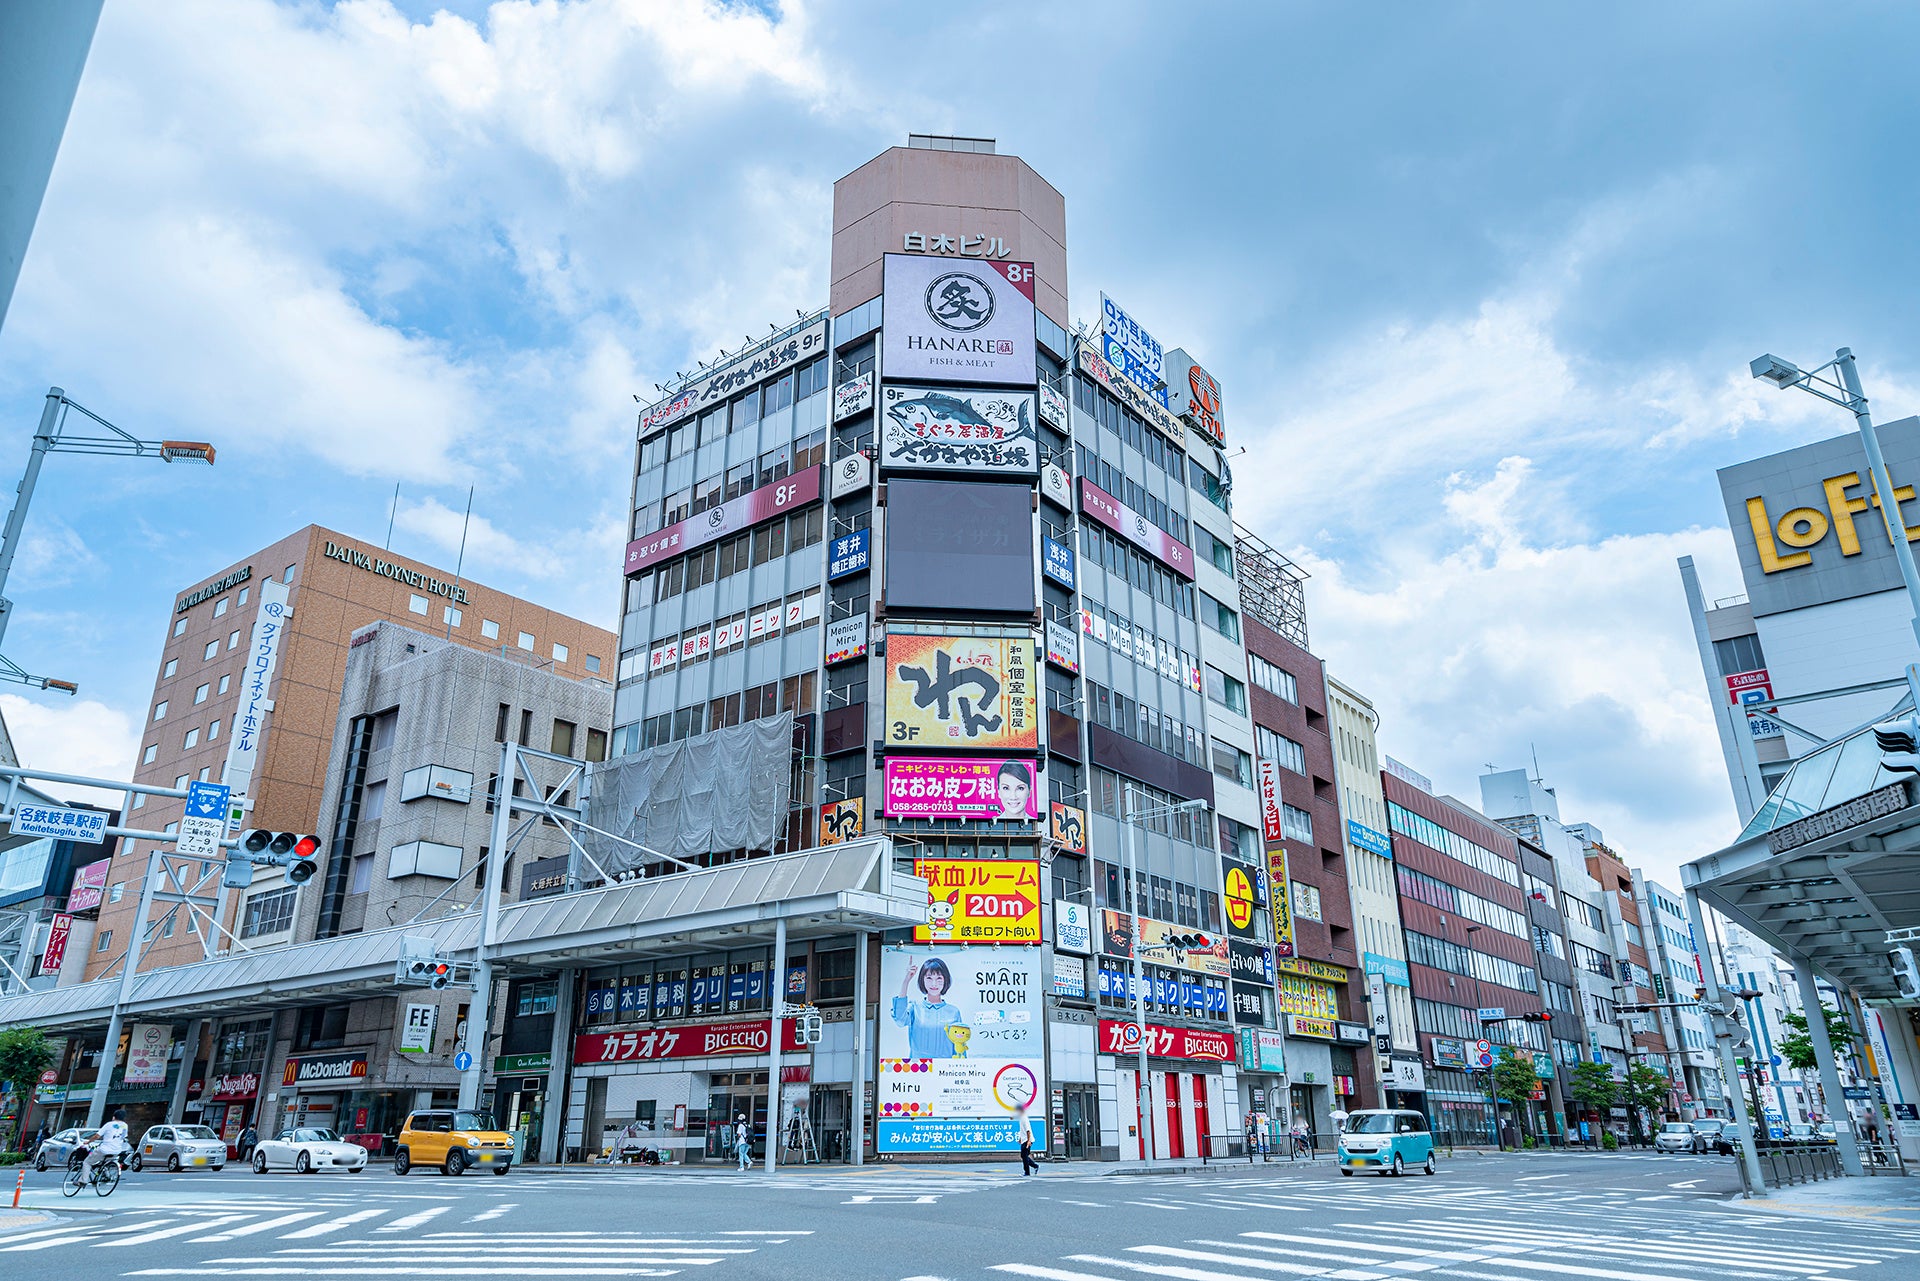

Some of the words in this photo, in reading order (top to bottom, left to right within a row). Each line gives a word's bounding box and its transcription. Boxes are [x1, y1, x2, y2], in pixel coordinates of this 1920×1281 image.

[903, 231, 1011, 258] 白木ビル
[1007, 263, 1033, 283] 8F
[802, 330, 823, 351] 9F
[908, 335, 995, 355] HANARE
[1108, 320, 1160, 373] クリニック
[929, 357, 953, 367] FISH
[955, 358, 964, 367] &
[965, 359, 996, 368] MEAT
[886, 388, 905, 401] 9F
[1172, 422, 1184, 440] 9F
[774, 483, 797, 507] 8F
[837, 536, 861, 558] 浅井
[1050, 542, 1068, 565] 浅井
[1171, 545, 1182, 562] 8F
[325, 541, 372, 570] DAIWA
[374, 559, 426, 590] ROYNET
[427, 577, 471, 605] HOTEL
[830, 550, 866, 577] 矯正歯科
[225, 565, 252, 589] HOTEL
[652, 605, 801, 666] 青木眼科クリニック
[830, 621, 863, 638] Menicon
[836, 633, 857, 647] Miru
[1050, 624, 1075, 647] Menicon
[1053, 640, 1071, 655] Miru
[1111, 628, 1151, 661] Menicon
[238, 622, 281, 751] ダイワロイネットホテル
[1008, 645, 1025, 728] 和風個室居酒屋
[892, 721, 921, 741] 3F
[891, 776, 997, 800] なおみ皮フ科
[892, 802, 954, 812] 058-265-0703
[19, 807, 104, 831] 名鉄岐阜駅前
[20, 822, 77, 838] Meitetsugifu
[79, 829, 97, 840] Sta.
[1362, 827, 1377, 843] Brain
[180, 844, 214, 854] ここから
[917, 865, 1037, 887] 献血ルーム
[969, 896, 1024, 916] 20m
[960, 925, 1036, 937] 岐阜ロフト向い
[975, 969, 1028, 985] SMART
[603, 974, 776, 1010] 白木耳鼻科クリニッ
[979, 989, 1026, 1004] TOUCH
[1233, 992, 1261, 1015] 千里眼
[729, 1022, 762, 1031] Entertainment
[600, 1031, 680, 1060] カラオケ
[704, 1033, 729, 1053] BIG
[730, 1029, 768, 1049] ECHO
[1109, 1024, 1175, 1055] カオケ
[1184, 1037, 1202, 1055] BIG
[1203, 1040, 1228, 1058] ECHO
[1378, 1038, 1391, 1050] B1
[892, 1082, 921, 1093] Miru
